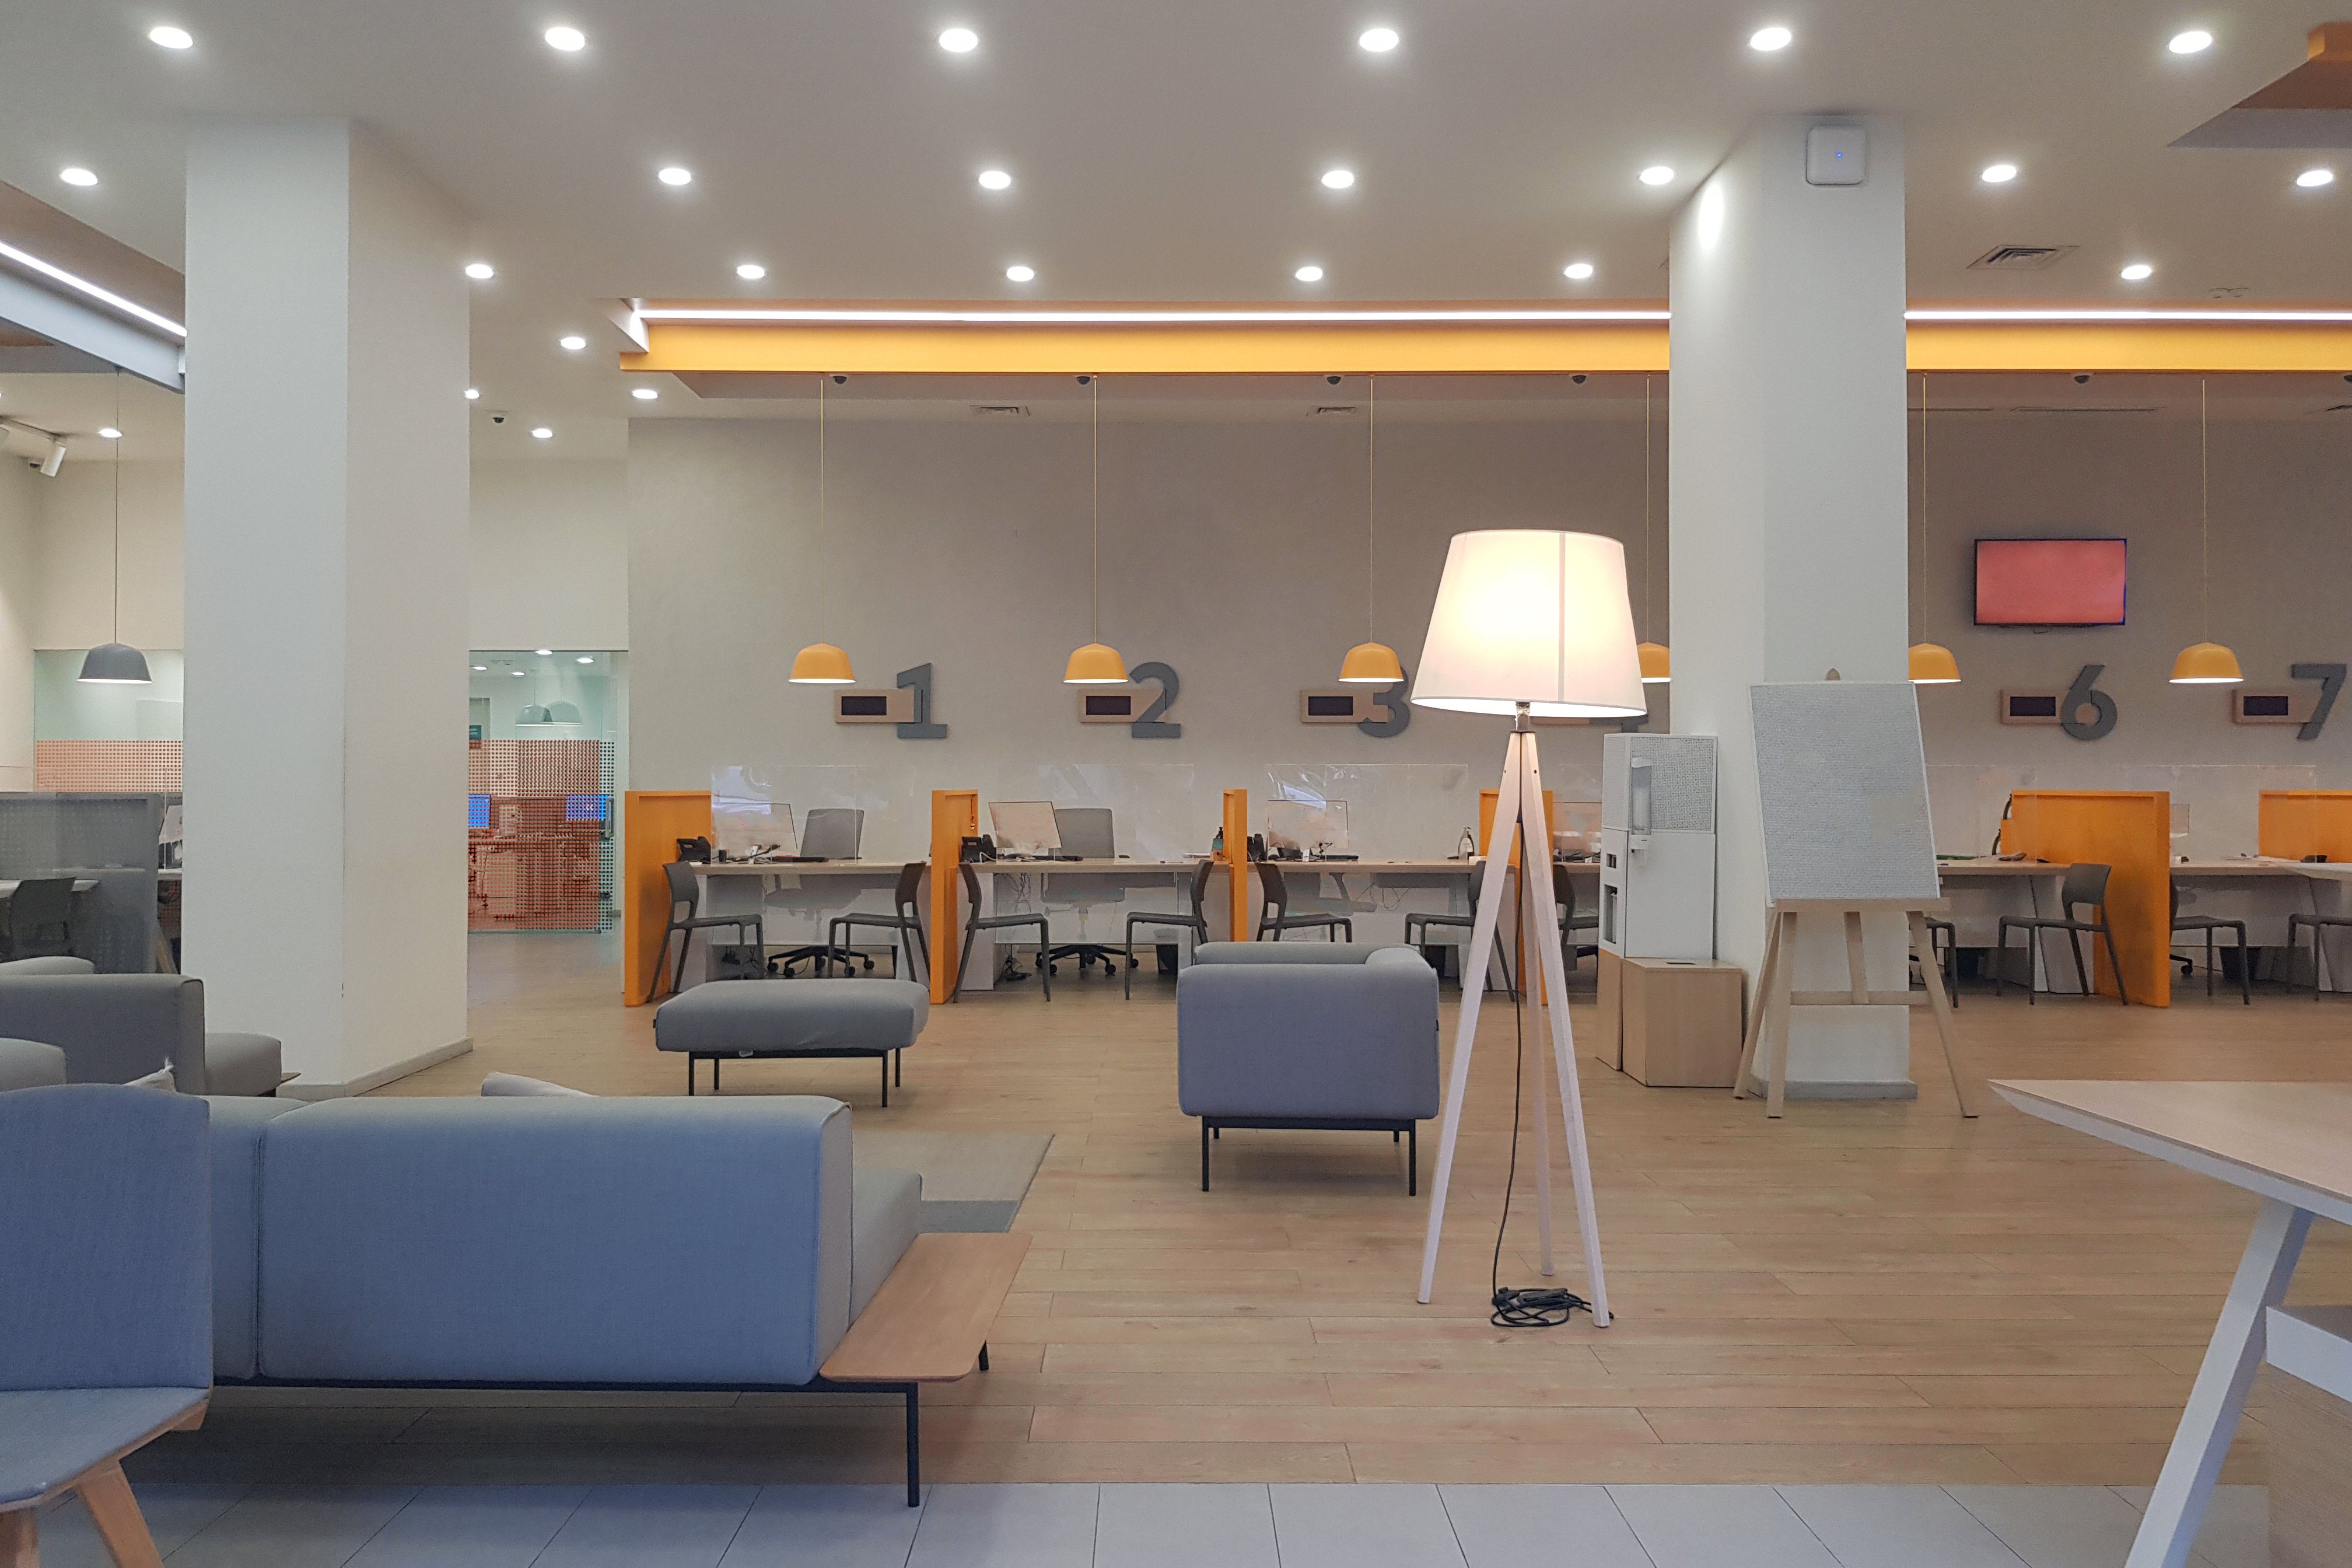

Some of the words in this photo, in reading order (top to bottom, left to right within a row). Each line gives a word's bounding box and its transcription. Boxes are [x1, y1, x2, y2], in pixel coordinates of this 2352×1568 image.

[897, 663, 947, 738] 1
[1129, 662, 1181, 738] 2
[1358, 666, 1410, 738] 3
[2060, 664, 2118, 740] 6
[2291, 663, 2347, 740] 7
